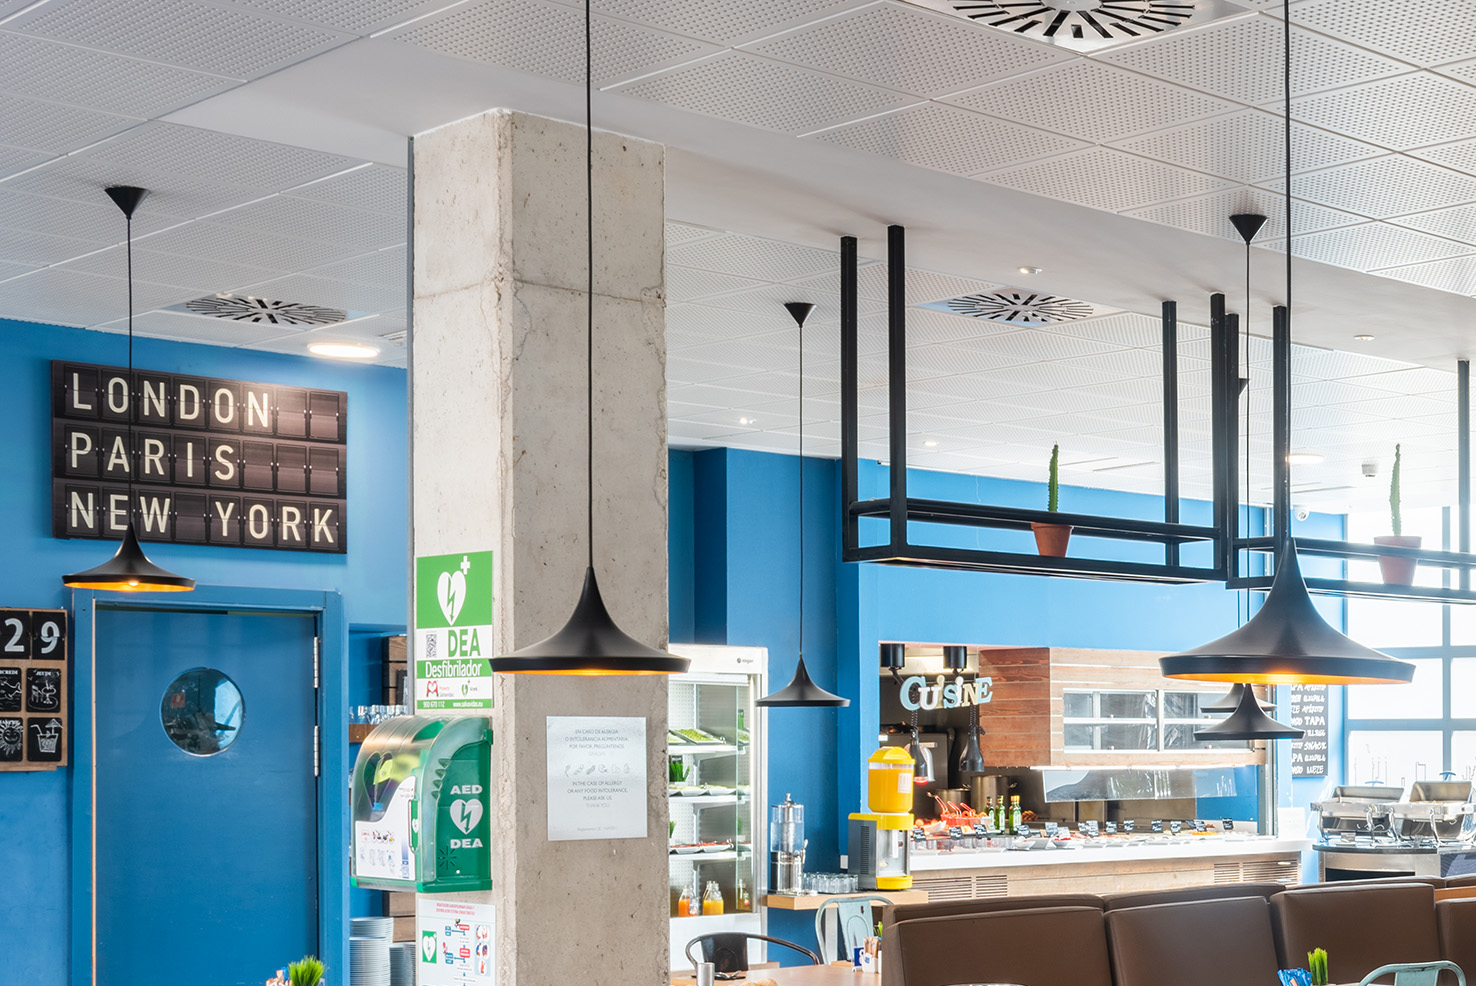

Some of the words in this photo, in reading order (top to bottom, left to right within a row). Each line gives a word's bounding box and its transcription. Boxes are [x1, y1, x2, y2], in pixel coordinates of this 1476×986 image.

[72, 372, 269, 428] LONDON
[71, 431, 235, 481] PARIS
[71, 491, 171, 534] NEW
[214, 501, 335, 544] YORK
[448, 628, 481, 657] DEA
[425, 660, 482, 678] Desfibrilador
[1304, 716, 1325, 726] TAPA
[450, 784, 483, 795] AED
[450, 838, 483, 849] DEA
